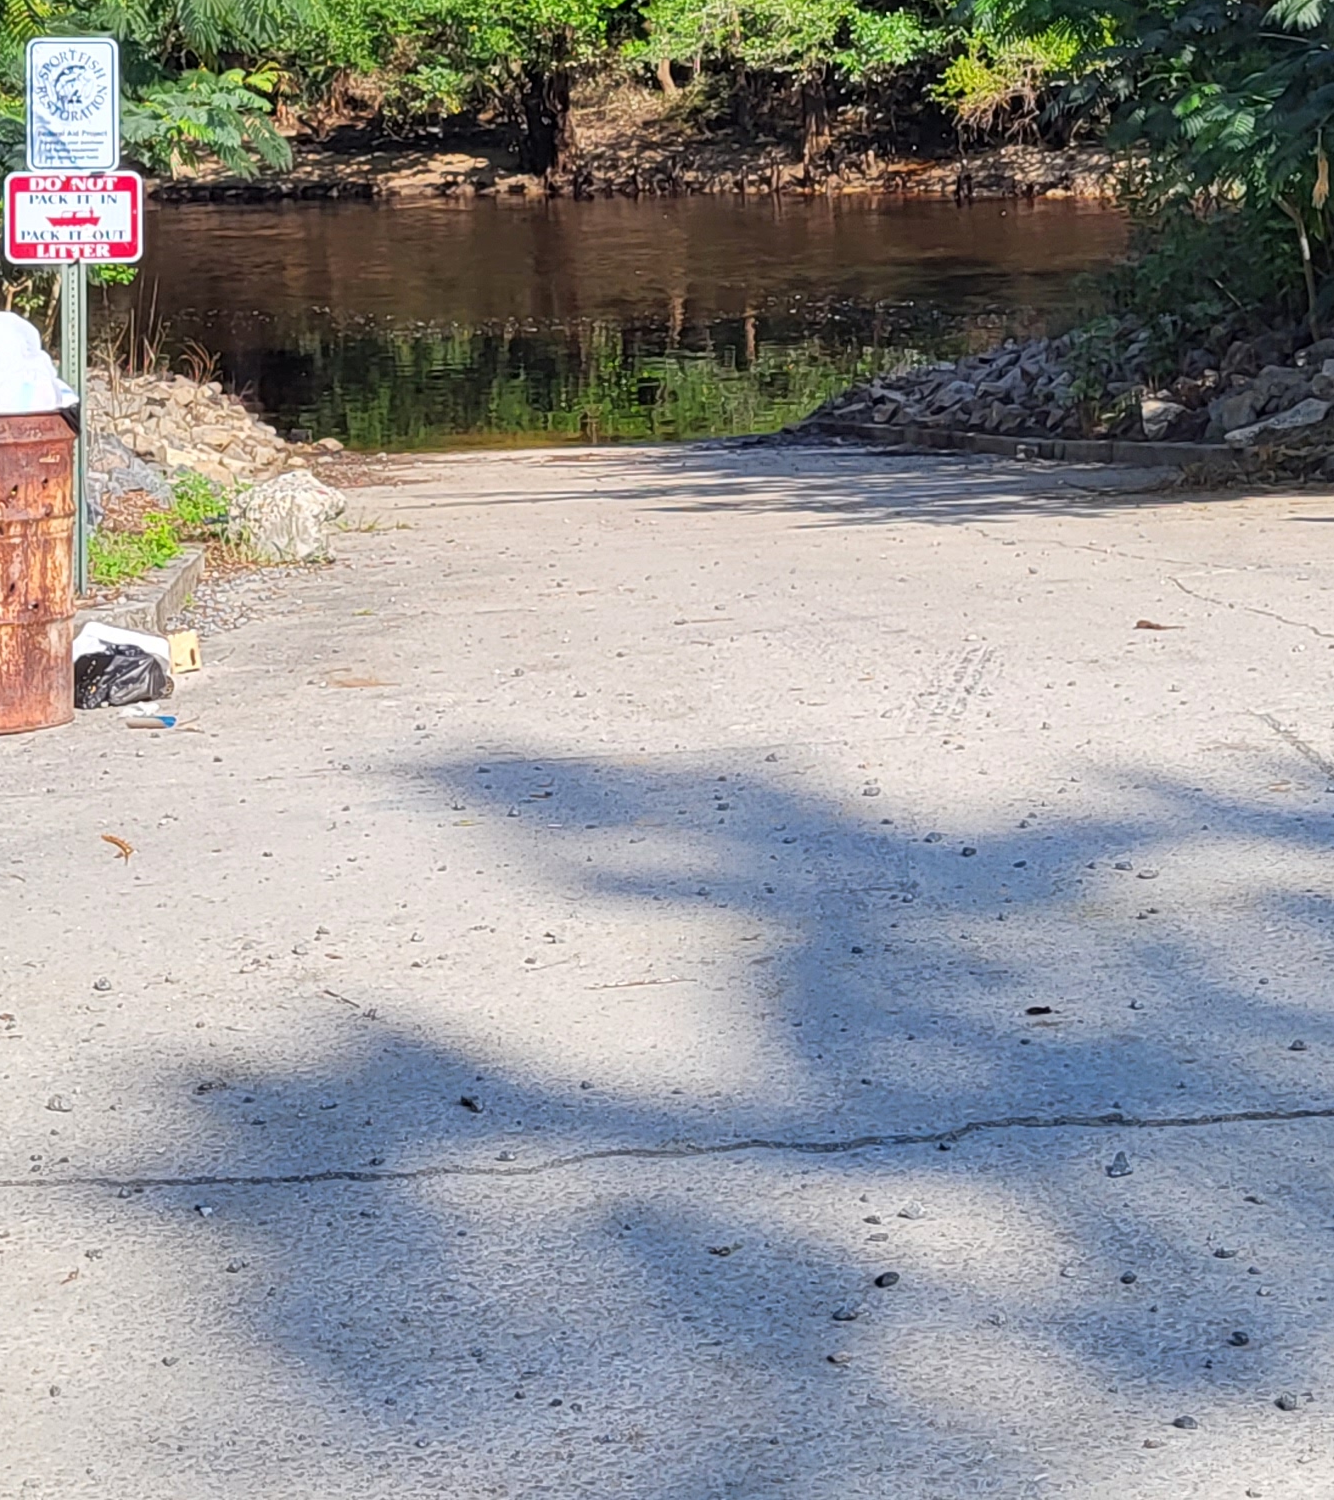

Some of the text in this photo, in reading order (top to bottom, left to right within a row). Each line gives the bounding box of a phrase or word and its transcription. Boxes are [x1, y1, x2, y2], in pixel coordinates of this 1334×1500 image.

[38, 47, 106, 81] SPORT FISH
[35, 84, 108, 122] RESTORATION
[29, 177, 118, 191] DO NOT
[29, 194, 118, 204] PACK IT IN
[21, 230, 127, 240] PACK IT OUT
[36, 243, 112, 258] LITTER
